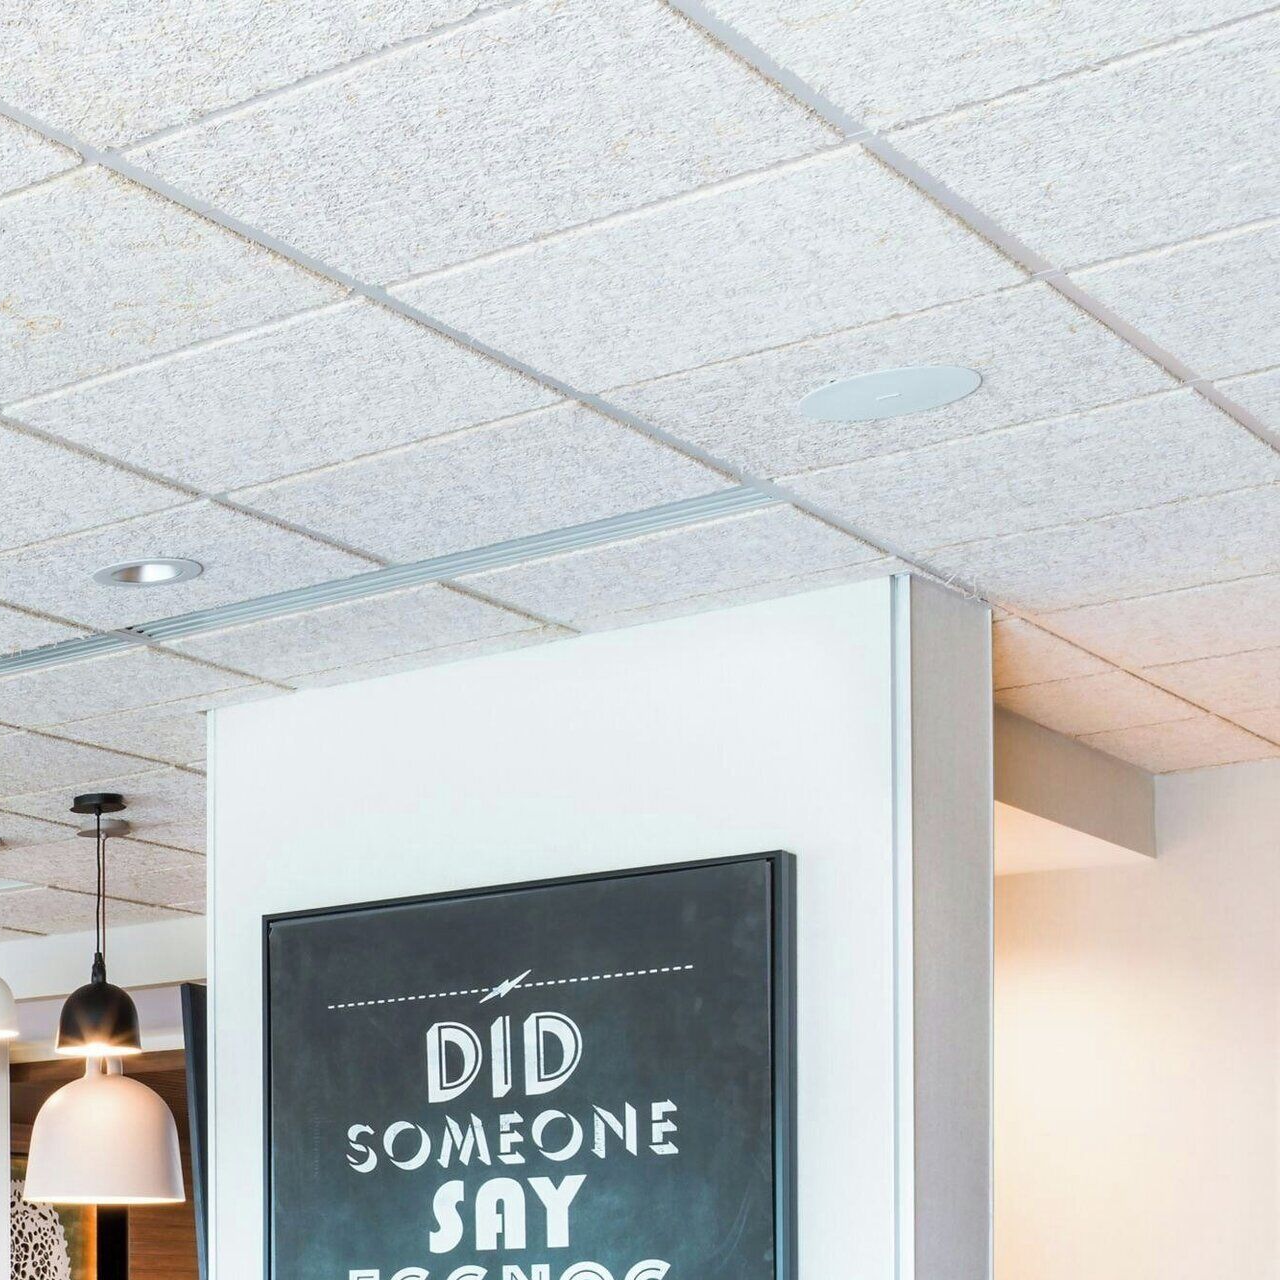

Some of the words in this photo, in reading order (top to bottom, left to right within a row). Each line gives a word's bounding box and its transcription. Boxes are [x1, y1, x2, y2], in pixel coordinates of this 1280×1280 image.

[426, 1011, 583, 1104] DID
[346, 1098, 679, 1174] SOMEONE
[428, 1173, 588, 1254] SAY
